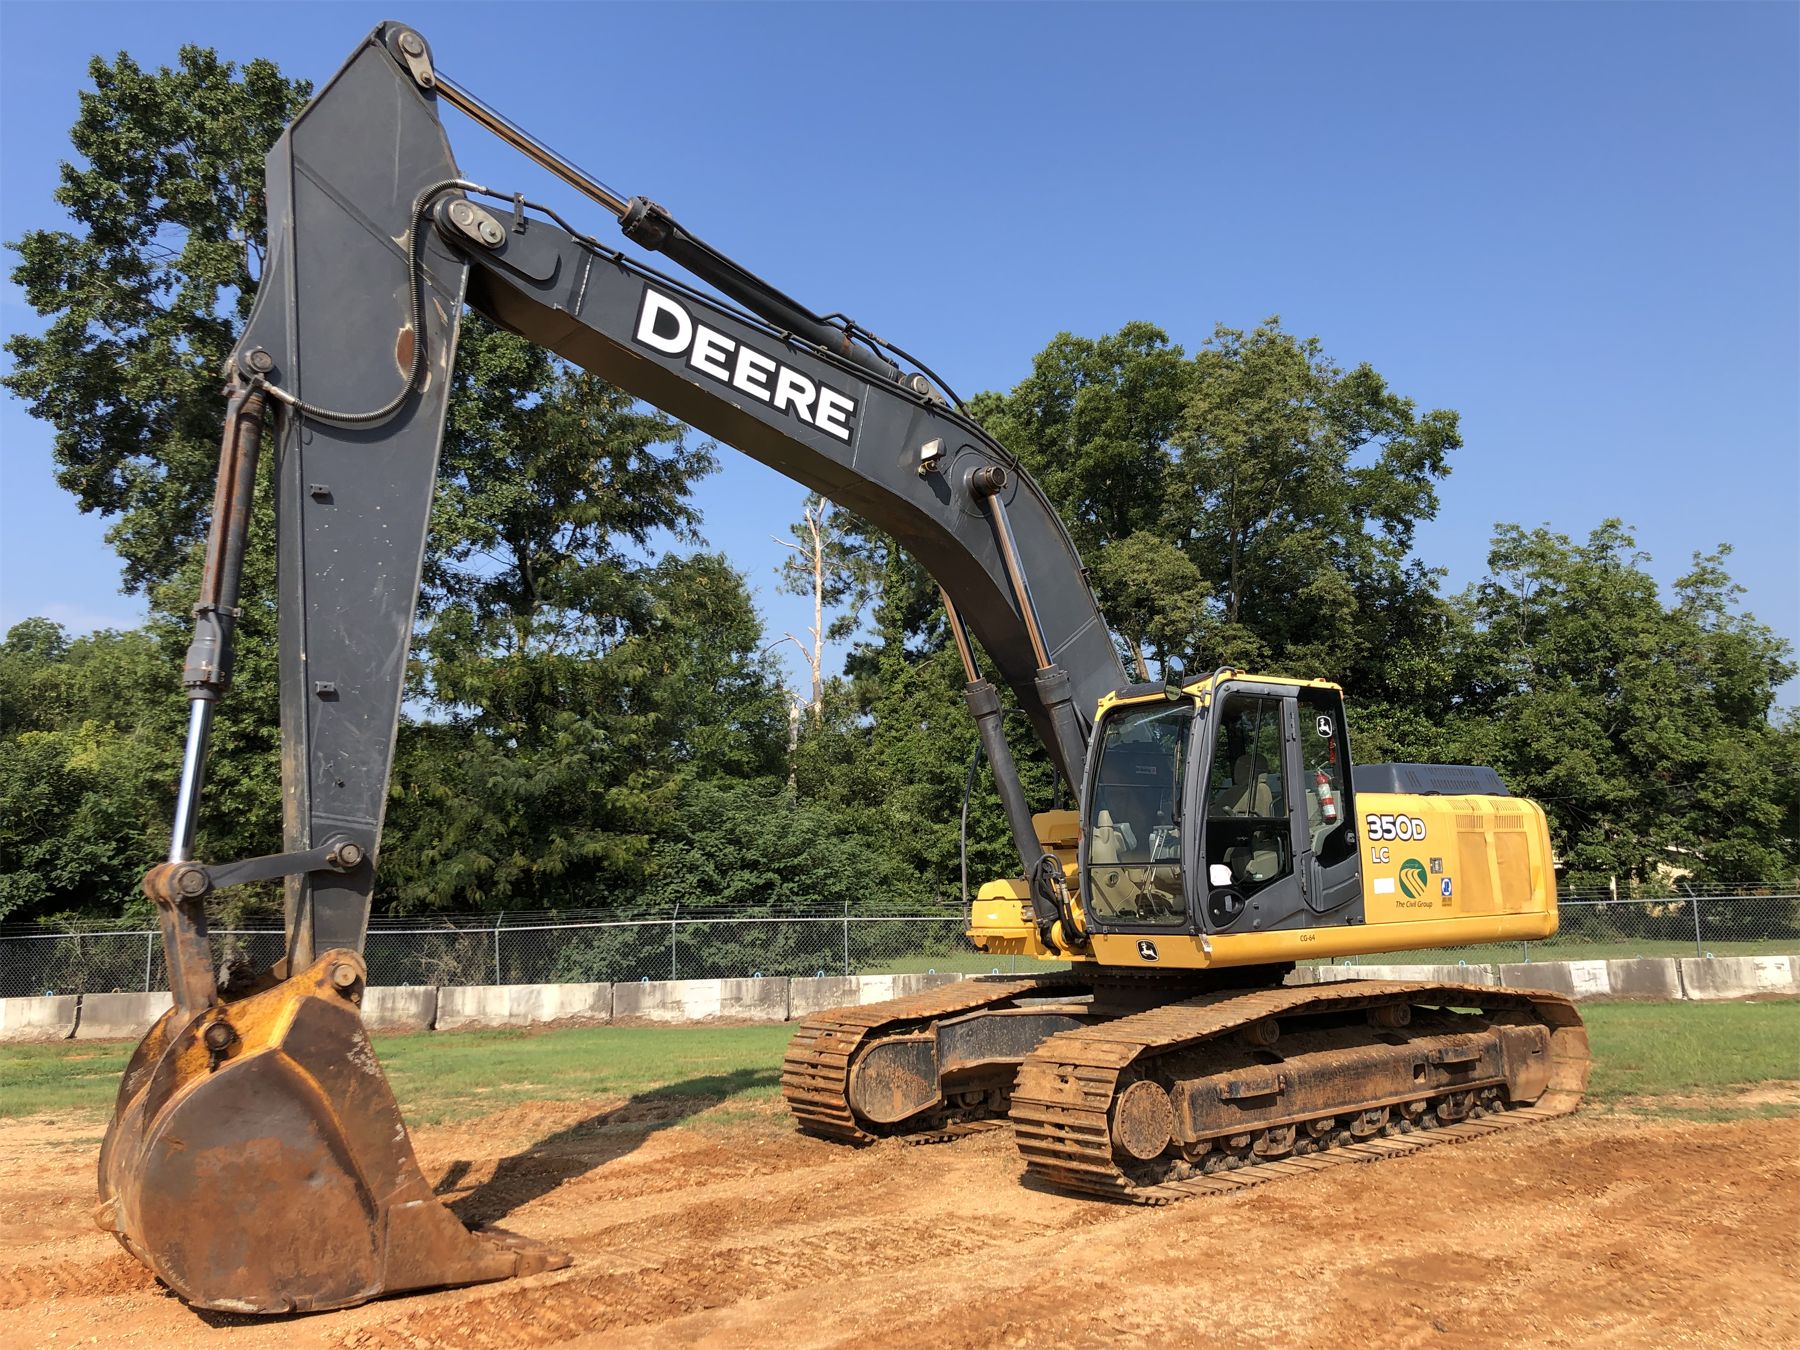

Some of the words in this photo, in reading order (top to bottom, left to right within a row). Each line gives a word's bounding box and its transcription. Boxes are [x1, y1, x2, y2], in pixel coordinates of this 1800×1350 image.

[635, 286, 856, 443] DEERE
[1366, 813, 1426, 841] 350D
[1371, 846, 1390, 864] LC
[1417, 901, 1432, 909] Group
